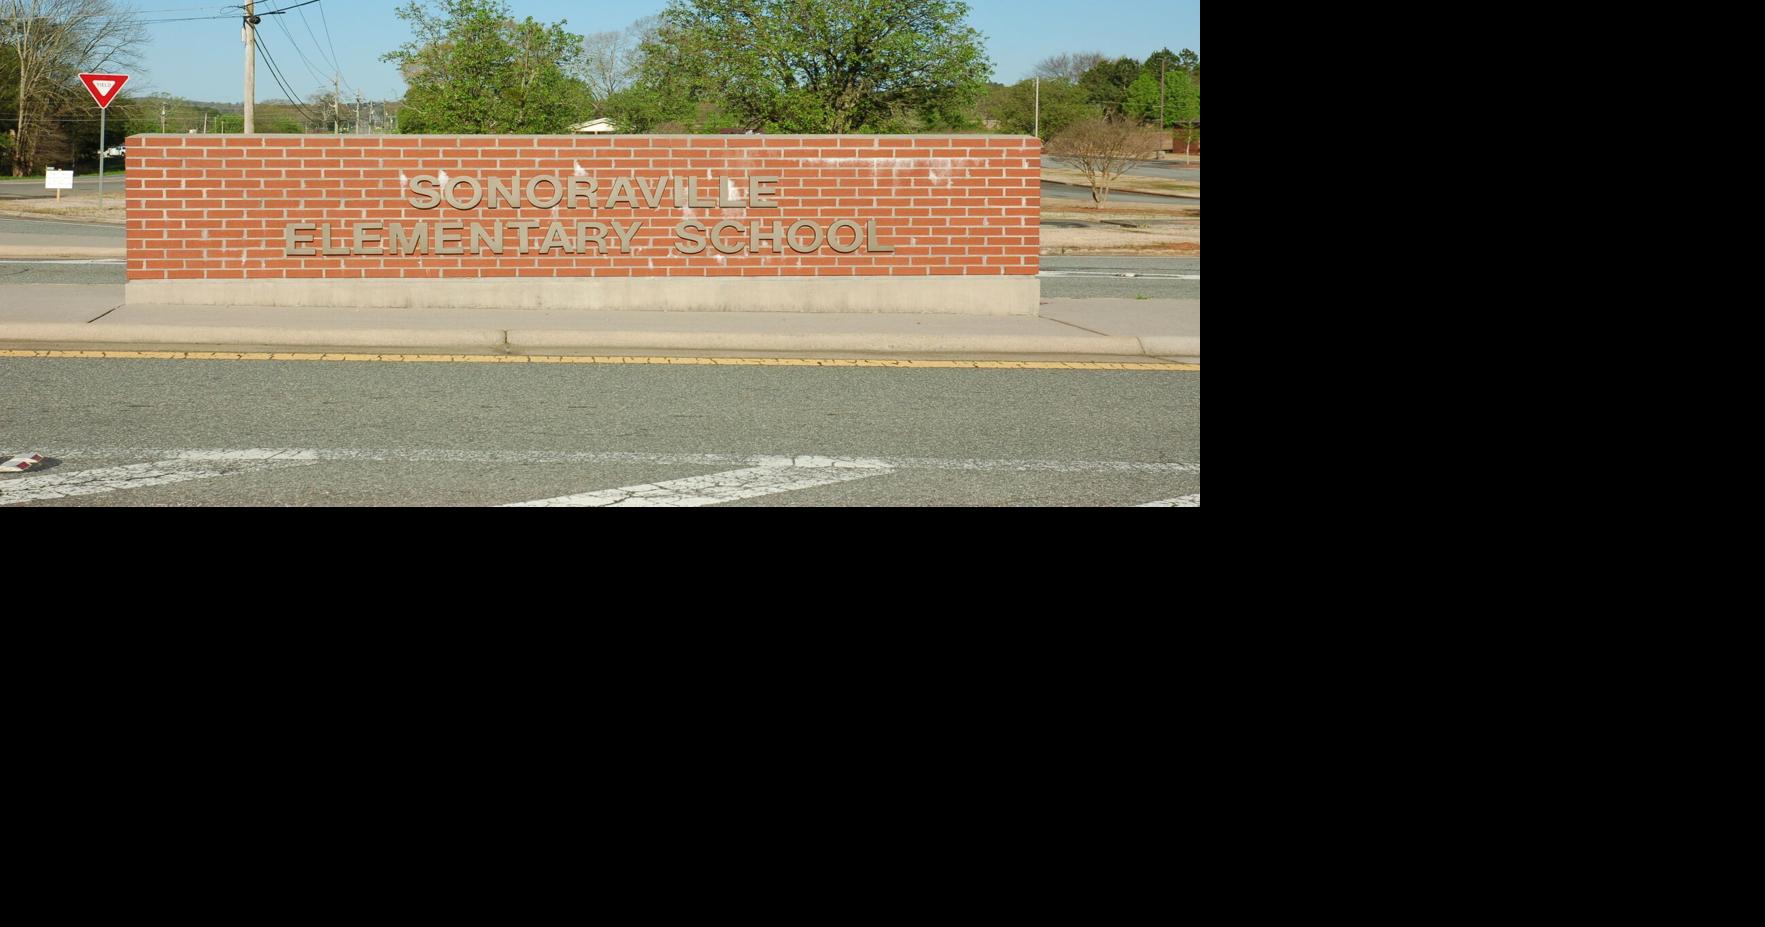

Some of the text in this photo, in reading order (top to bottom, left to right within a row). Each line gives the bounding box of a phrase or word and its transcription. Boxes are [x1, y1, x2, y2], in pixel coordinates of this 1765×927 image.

[408, 174, 779, 210] SONORAVILLE
[285, 220, 896, 256] ELEMENTARY SCHOOL
